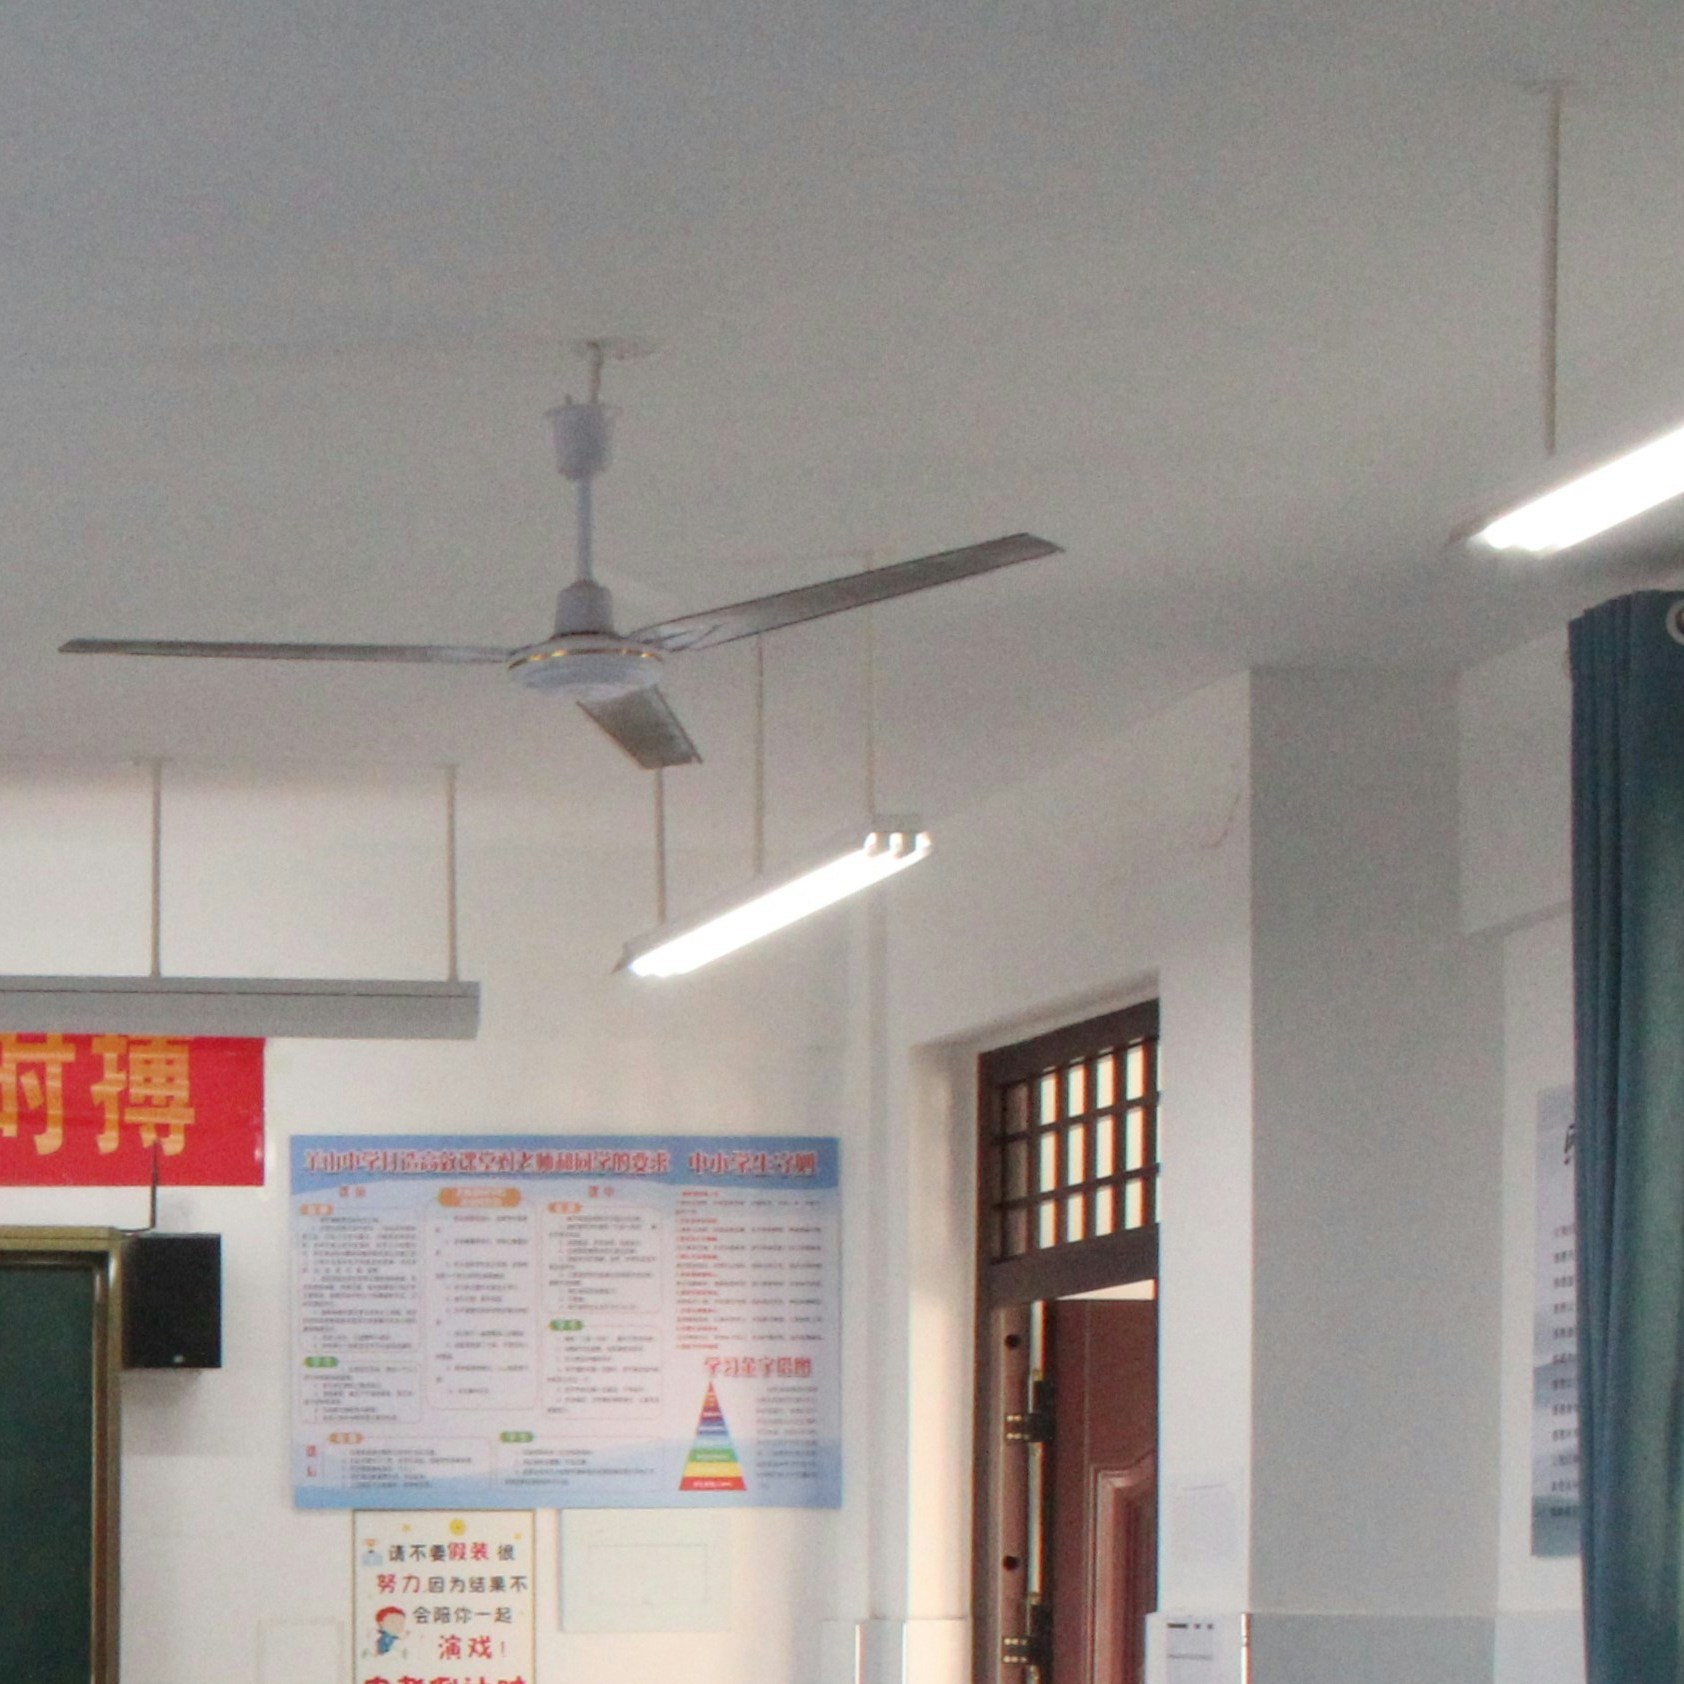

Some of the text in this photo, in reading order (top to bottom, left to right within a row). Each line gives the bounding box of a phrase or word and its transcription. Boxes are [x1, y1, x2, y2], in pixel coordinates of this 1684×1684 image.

[413, 1607, 512, 1624] 会陪你一起
